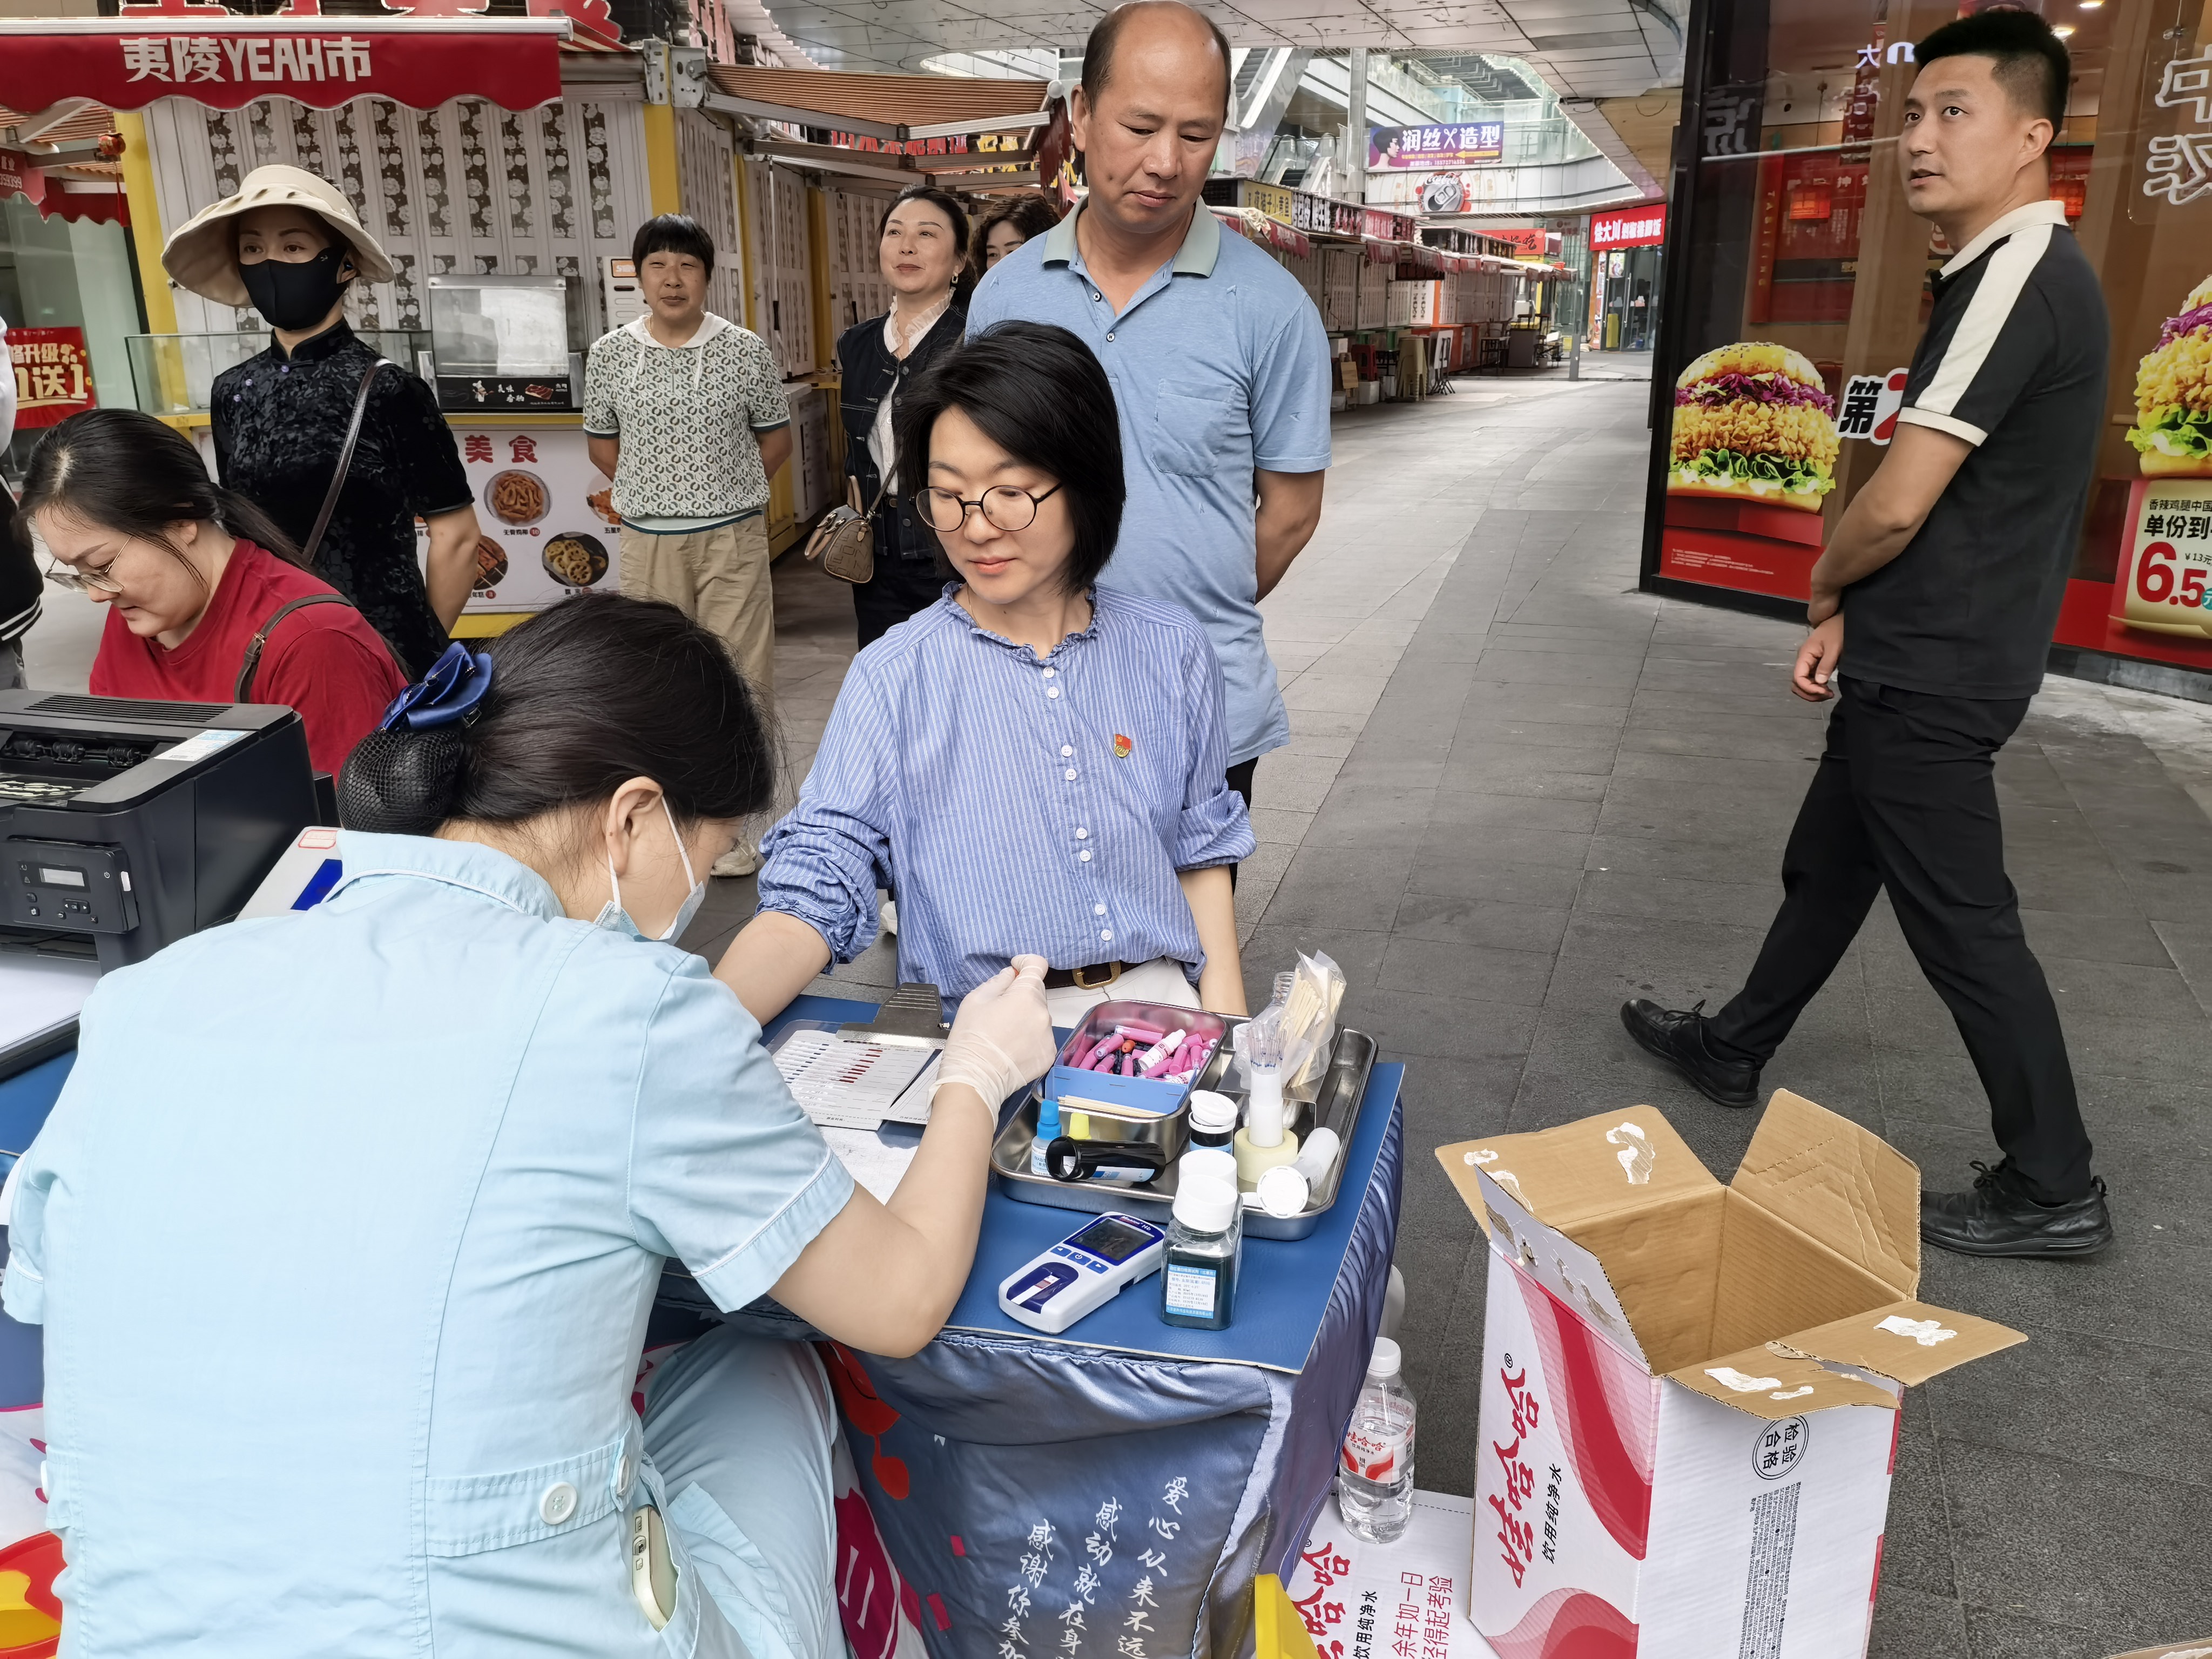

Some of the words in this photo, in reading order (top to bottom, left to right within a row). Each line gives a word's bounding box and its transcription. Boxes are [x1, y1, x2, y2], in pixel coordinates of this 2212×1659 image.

[119, 36, 372, 83] 夷陵YEAH市
[1460, 125, 1500, 150] 造型
[464, 434, 538, 463] 美食
[2144, 514, 2212, 540] 单份到
[2136, 541, 2206, 608] 6.5
[1347, 1431, 1386, 1452] 娃哈哈
[1352, 1442, 1375, 1456] 饮用纯净水
[1762, 1430, 1782, 1470] 合格
[1782, 1422, 1800, 1465] 检验
[1488, 1367, 1540, 1589] 娃哈哈
[1541, 1463, 1562, 1564] 饮用纯净水
[998, 1518, 1056, 1659] 感谢你参加
[1055, 1496, 1123, 1659] 感动就在身
[1117, 1475, 1189, 1659] 爱心从来不远
[1353, 1590, 1378, 1659] 饮用纯净水
